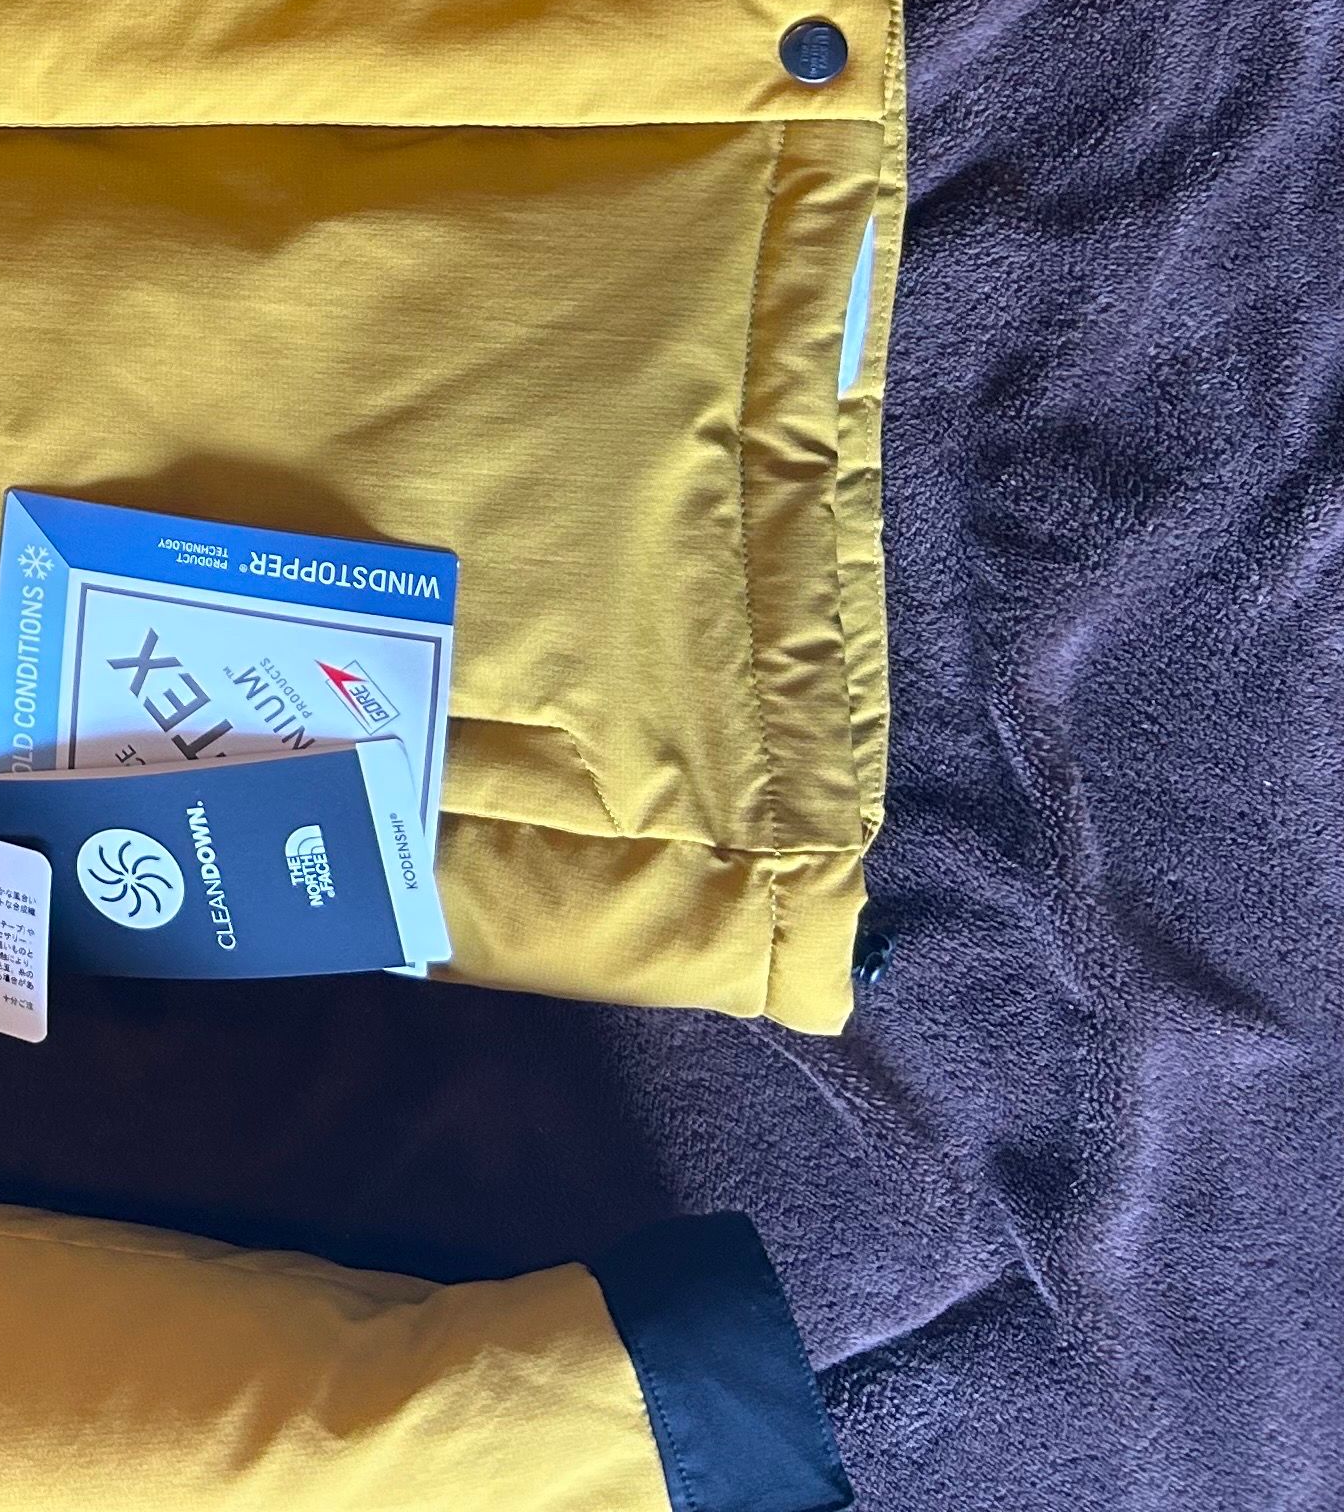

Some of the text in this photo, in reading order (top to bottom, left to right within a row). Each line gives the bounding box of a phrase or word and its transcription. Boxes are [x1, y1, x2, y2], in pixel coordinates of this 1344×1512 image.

[157, 537, 227, 557] TECHNOLOGY
[176, 551, 227, 569] PRODUCT
[12, 585, 44, 772] OLD CONDITIONS
[105, 627, 233, 763] TEX
[259, 656, 312, 719] PRODUCTS
[348, 683, 389, 722] GORE
[286, 856, 304, 885] THE
[300, 855, 323, 905] NORTH
